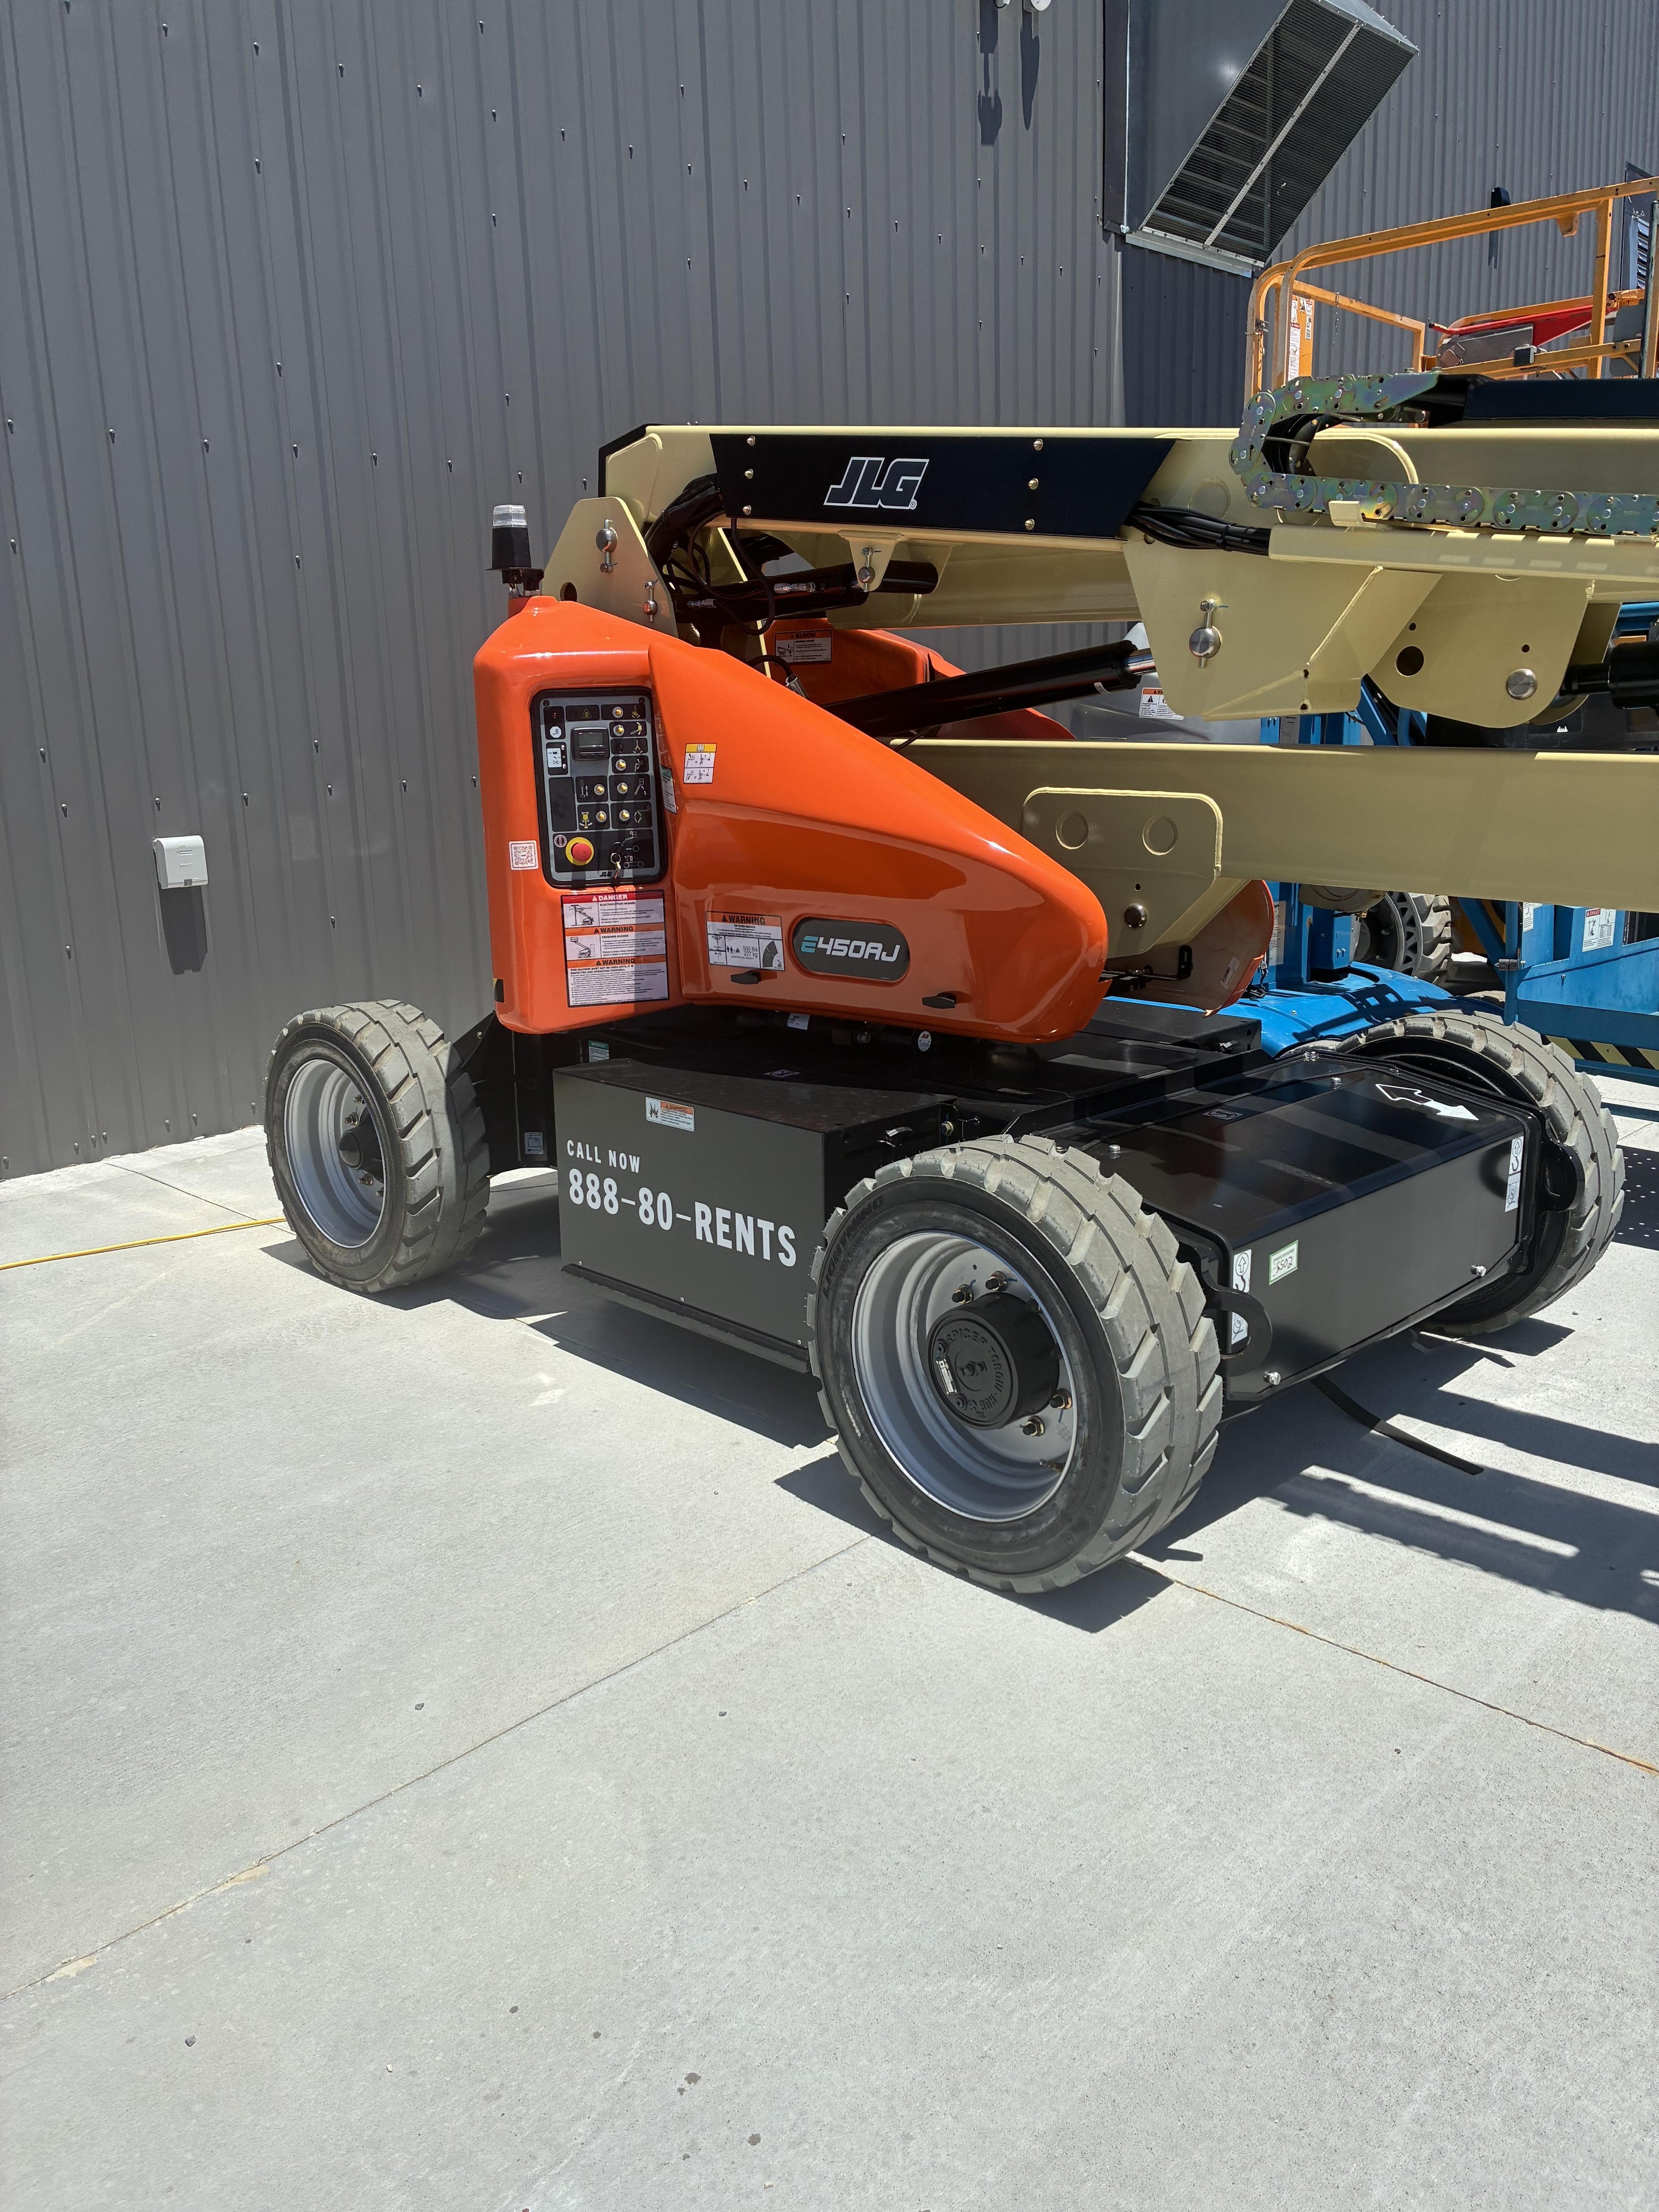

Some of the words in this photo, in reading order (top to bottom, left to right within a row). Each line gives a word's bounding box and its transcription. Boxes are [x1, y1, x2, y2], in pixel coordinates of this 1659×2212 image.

[823, 457, 929, 510] JLG
[729, 915, 766, 925] WARNING
[801, 936, 900, 962] E450AJ
[567, 1139, 601, 1164] CALL
[608, 1150, 640, 1173] NOW
[569, 1168, 797, 1267] 888-80-RENTS
[945, 1328, 987, 1345] SPICER
